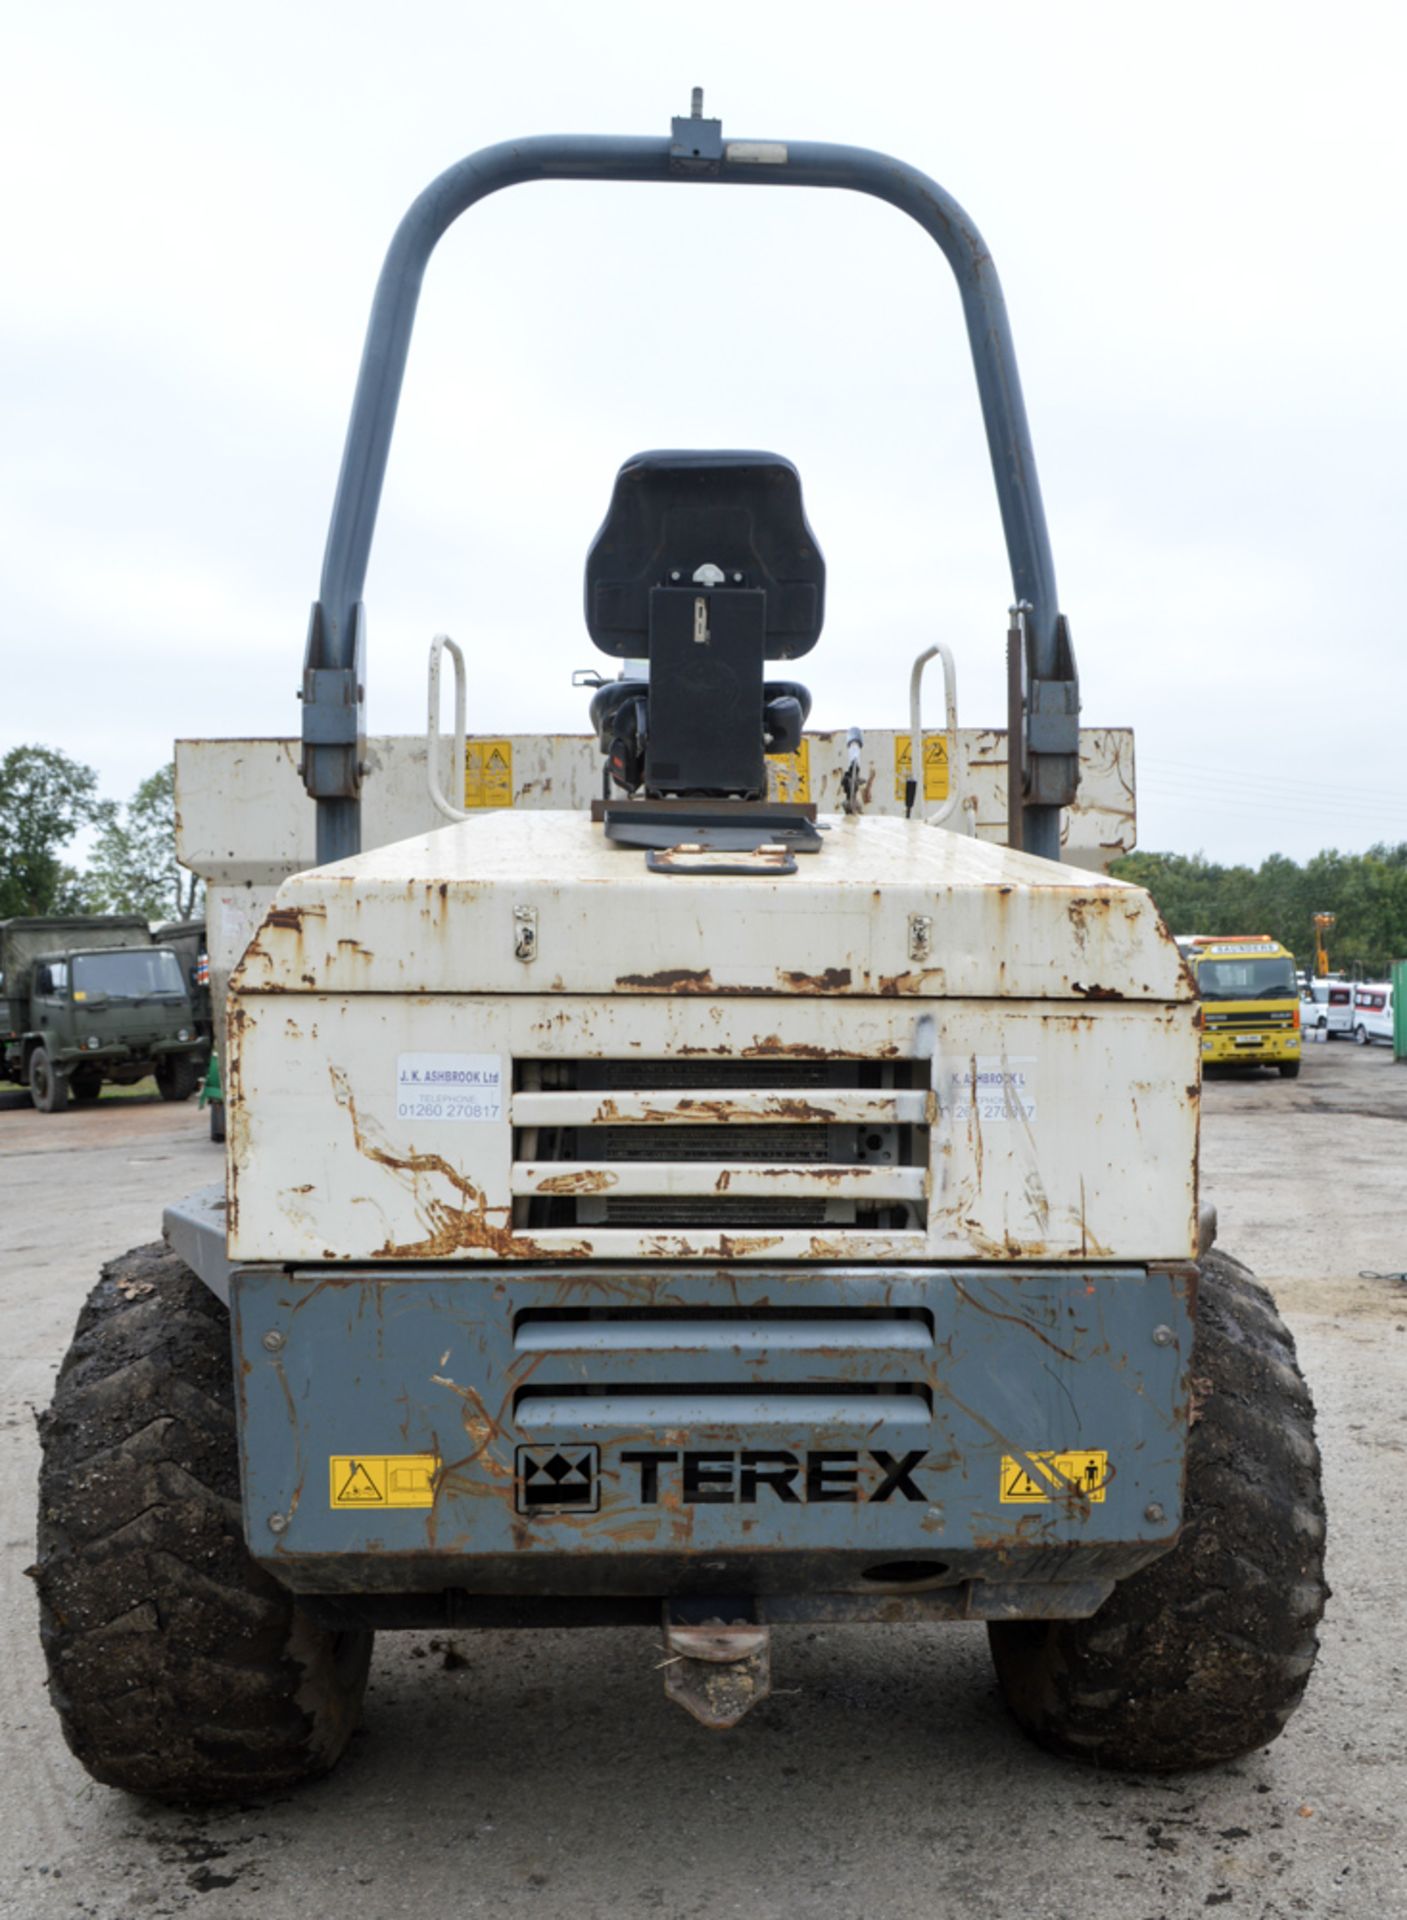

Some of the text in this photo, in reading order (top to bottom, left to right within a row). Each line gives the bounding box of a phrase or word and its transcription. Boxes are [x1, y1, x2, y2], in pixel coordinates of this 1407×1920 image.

[424, 1070, 481, 1083] ASHBROOK
[483, 1072, 499, 1083] Ltd
[963, 1073, 1017, 1084] AHBROOK
[419, 1094, 475, 1103] TELEPHONE
[446, 1104, 500, 1118] 270817
[620, 1450, 930, 1504] TEREX
